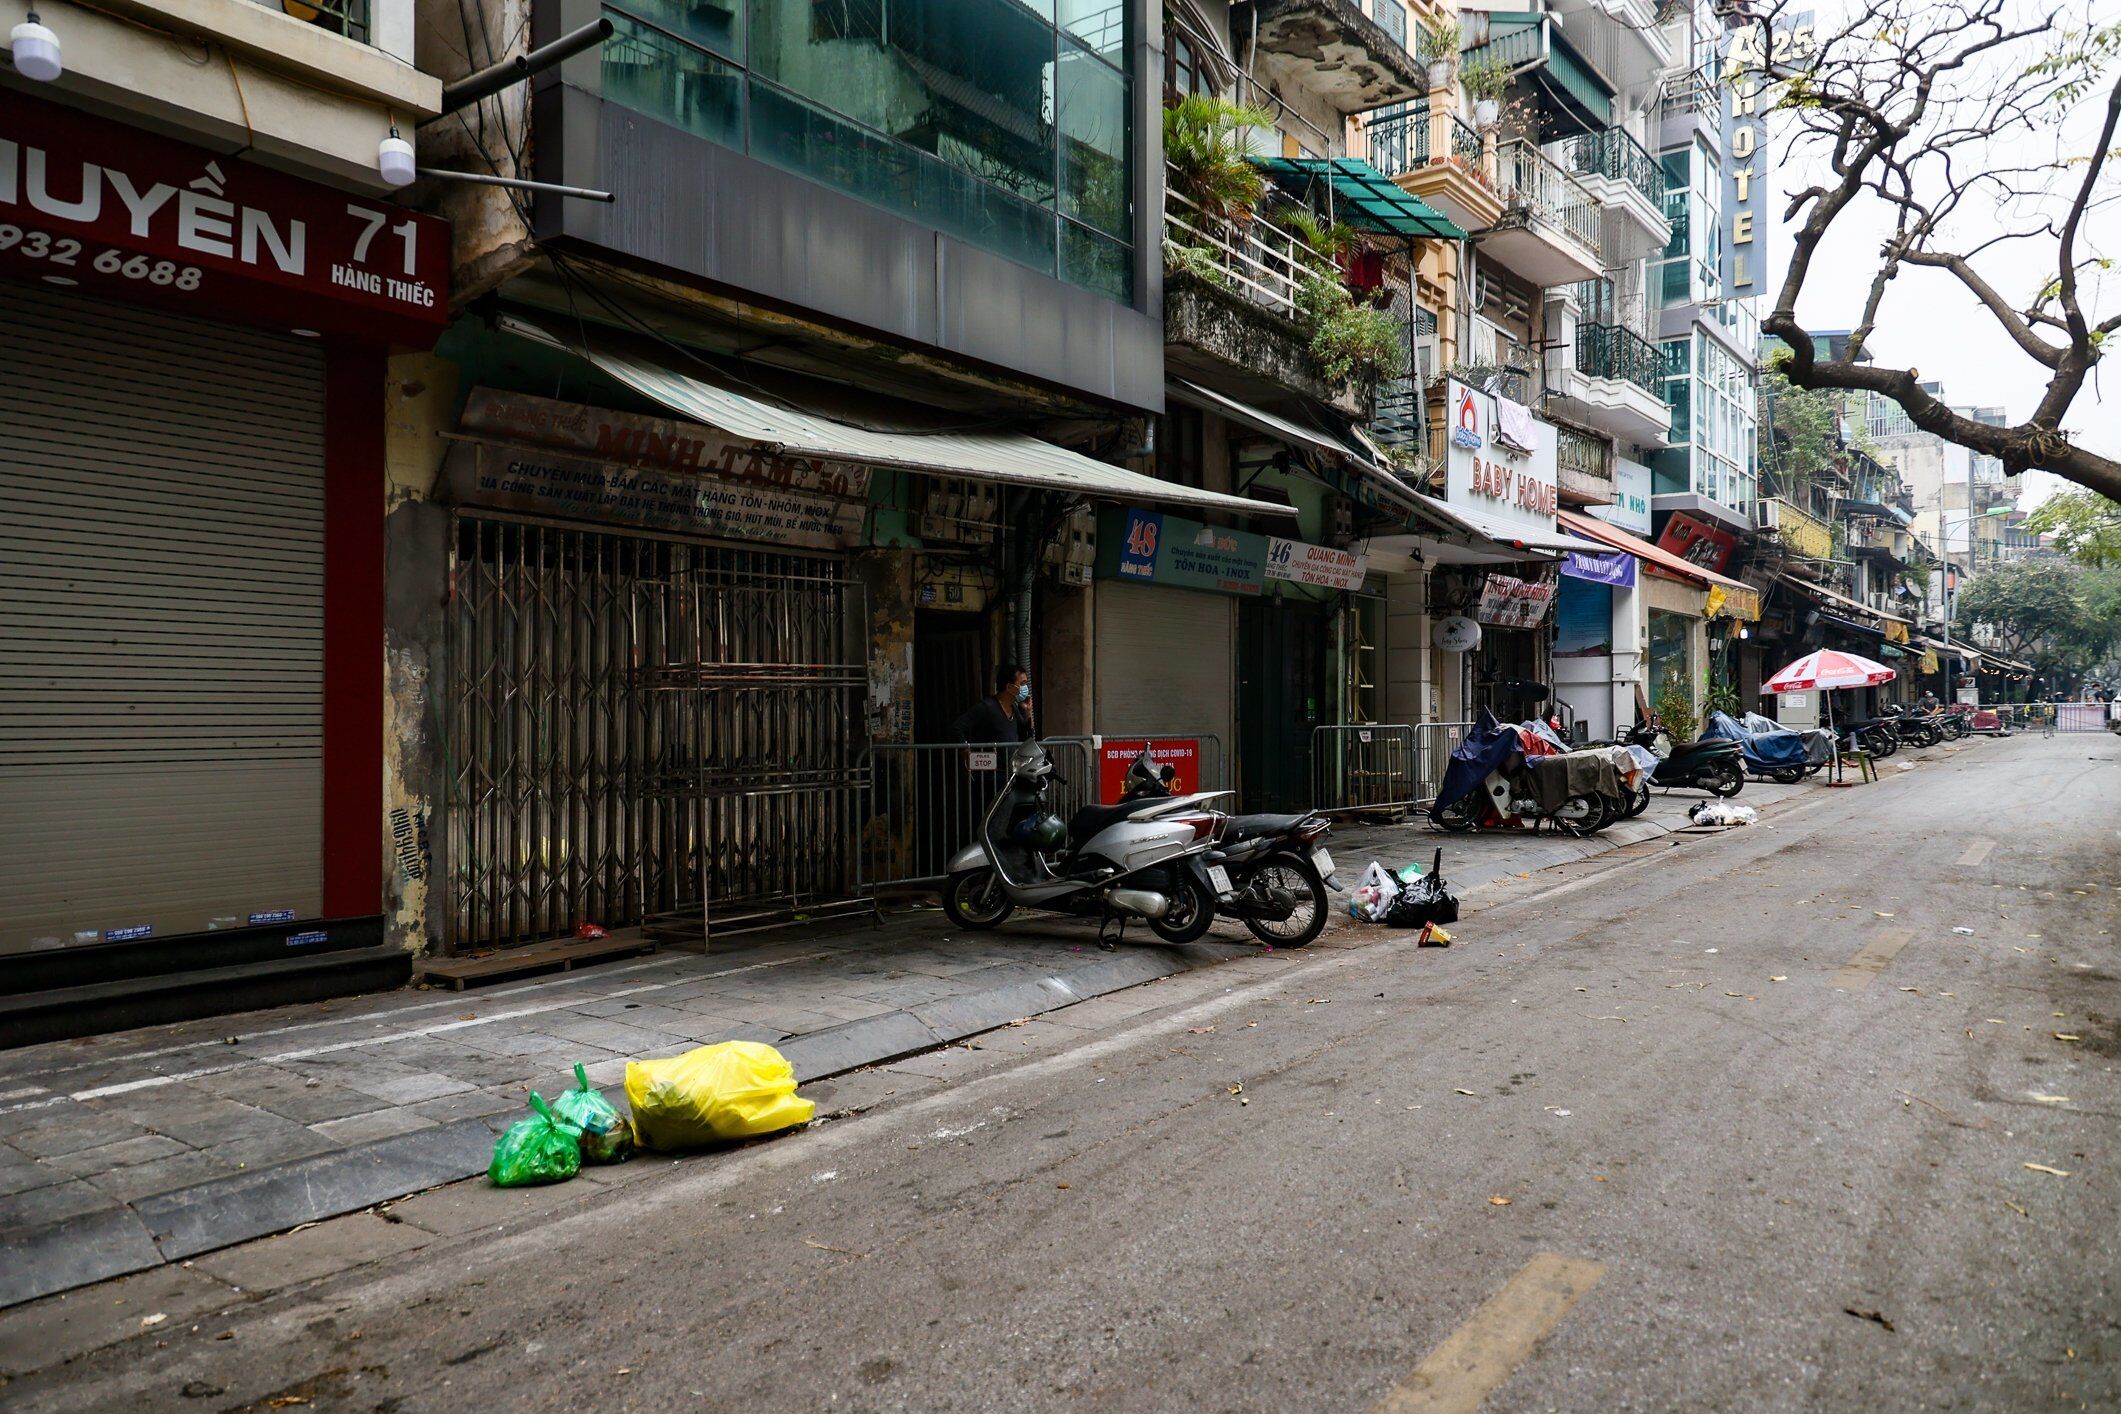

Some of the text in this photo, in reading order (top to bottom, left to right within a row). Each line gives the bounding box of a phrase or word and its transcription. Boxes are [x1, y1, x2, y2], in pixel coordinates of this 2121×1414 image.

[1731, 81, 1755, 288] HOTEL
[0, 137, 305, 277] UYỀN
[346, 203, 417, 277] 71
[93, 248, 203, 292] 6688
[331, 262, 435, 308] HÀNG THIẾC
[1472, 456, 1557, 516] BABY HOME
[1127, 518, 1158, 557] 48
[1270, 540, 1292, 564] 46
[1174, 559, 1197, 571] TÔN
[1198, 563, 1218, 575] HOA
[1226, 568, 1250, 579] INOX
[1307, 547, 1357, 568] QUANG MINH
[948, 586, 960, 600] 50
[1302, 571, 1316, 583] TÔN
[1315, 574, 1329, 585] HOA
[1333, 577, 1349, 588] INOX
[1170, 748, 1193, 758] COVID-19
